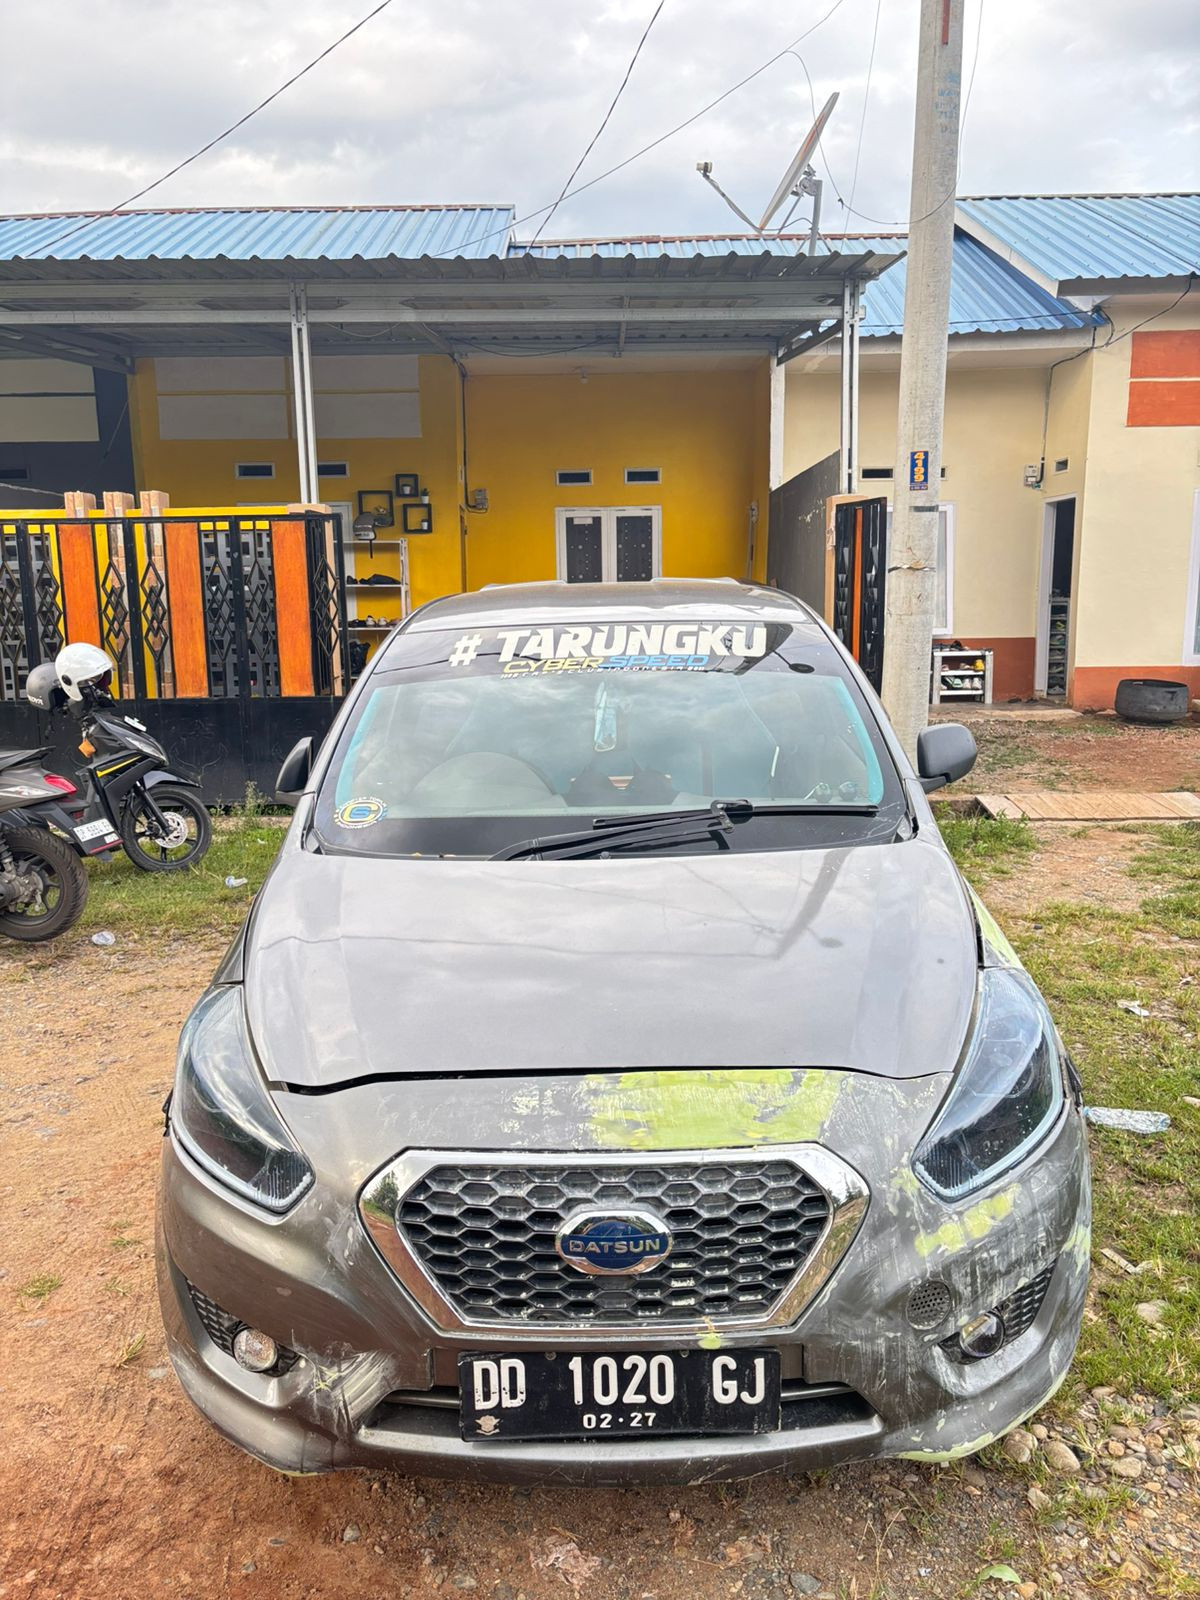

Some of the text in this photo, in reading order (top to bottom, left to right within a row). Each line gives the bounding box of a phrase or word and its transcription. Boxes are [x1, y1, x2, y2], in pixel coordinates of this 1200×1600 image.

[496, 625, 768, 662] TARUNGKU
[503, 655, 709, 673] CYBER SPEED
[569, 1238, 660, 1254] DATSUN
[473, 1354, 766, 1411] DD 1020 GJ
